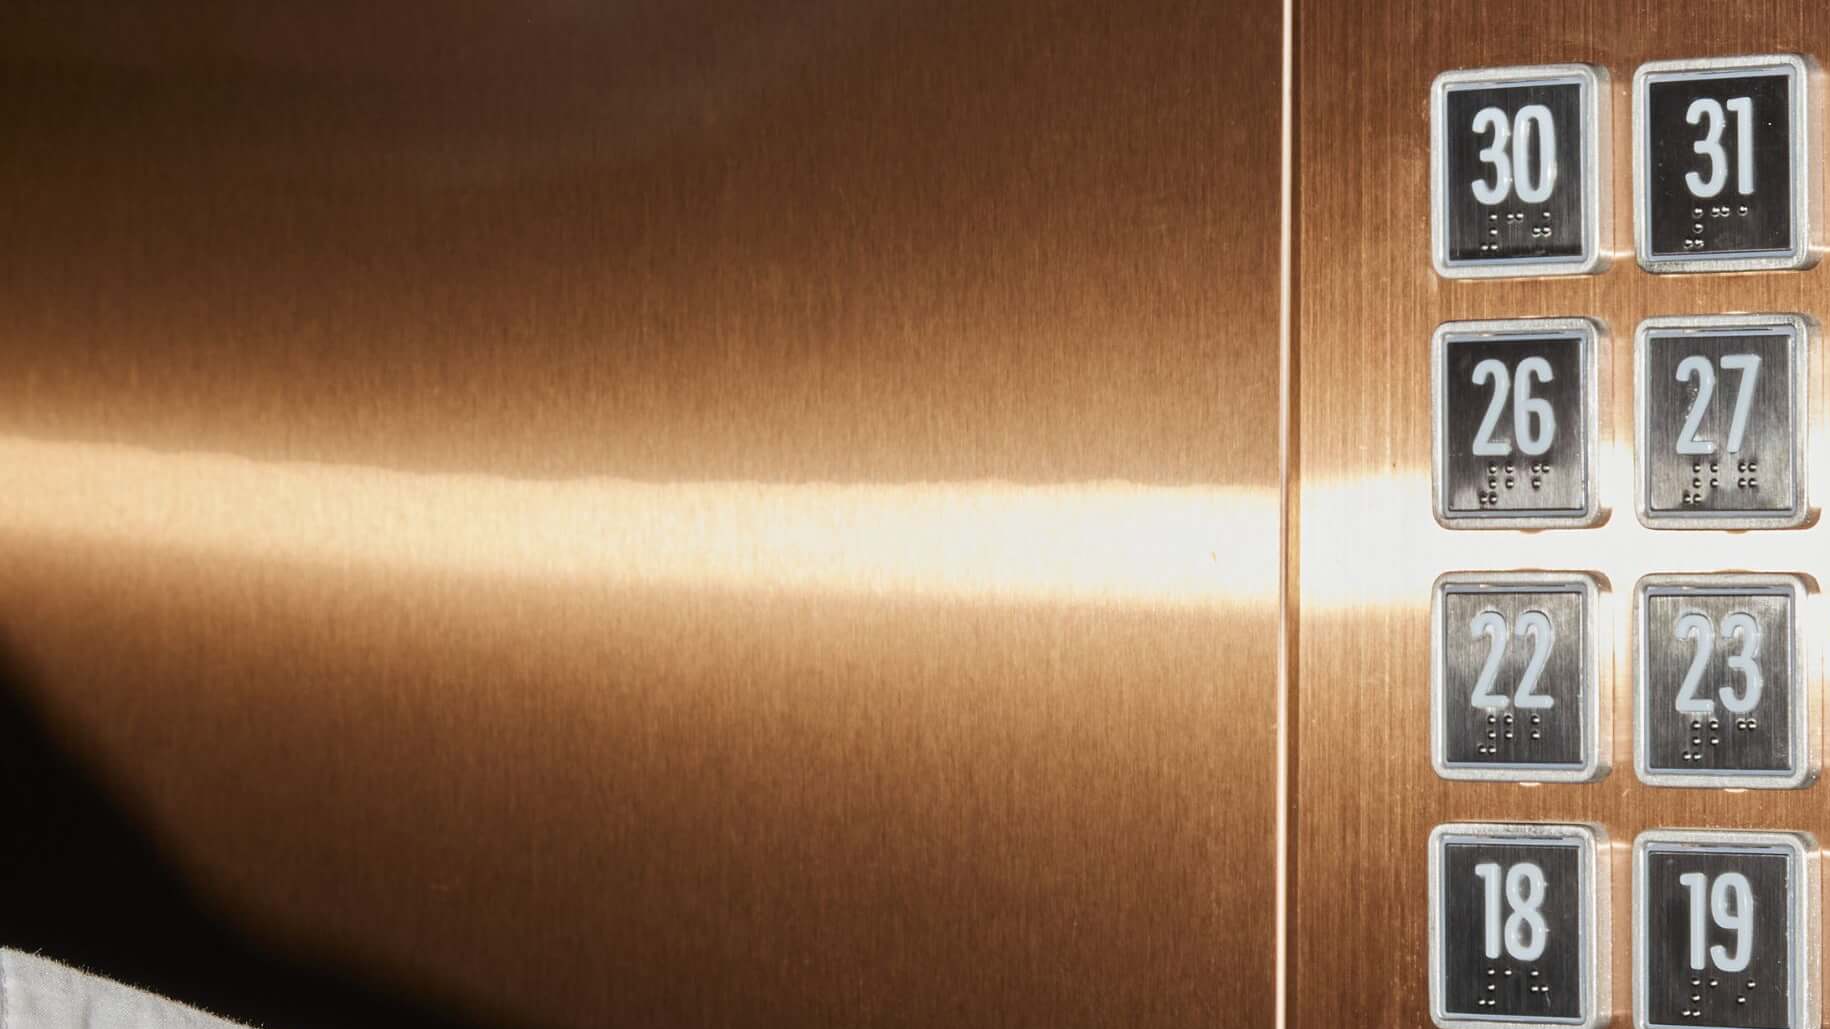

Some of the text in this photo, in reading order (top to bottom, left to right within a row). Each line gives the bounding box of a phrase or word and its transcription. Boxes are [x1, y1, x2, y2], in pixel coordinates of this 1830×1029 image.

[1470, 104, 1555, 203] 30
[1685, 97, 1754, 197] 31
[1472, 356, 1554, 455] 26
[1676, 354, 1762, 455] 27
[1470, 610, 1554, 709] 22
[1675, 612, 1762, 713] 23
[1475, 862, 1546, 961] 18
[1680, 872, 1753, 972] 19
